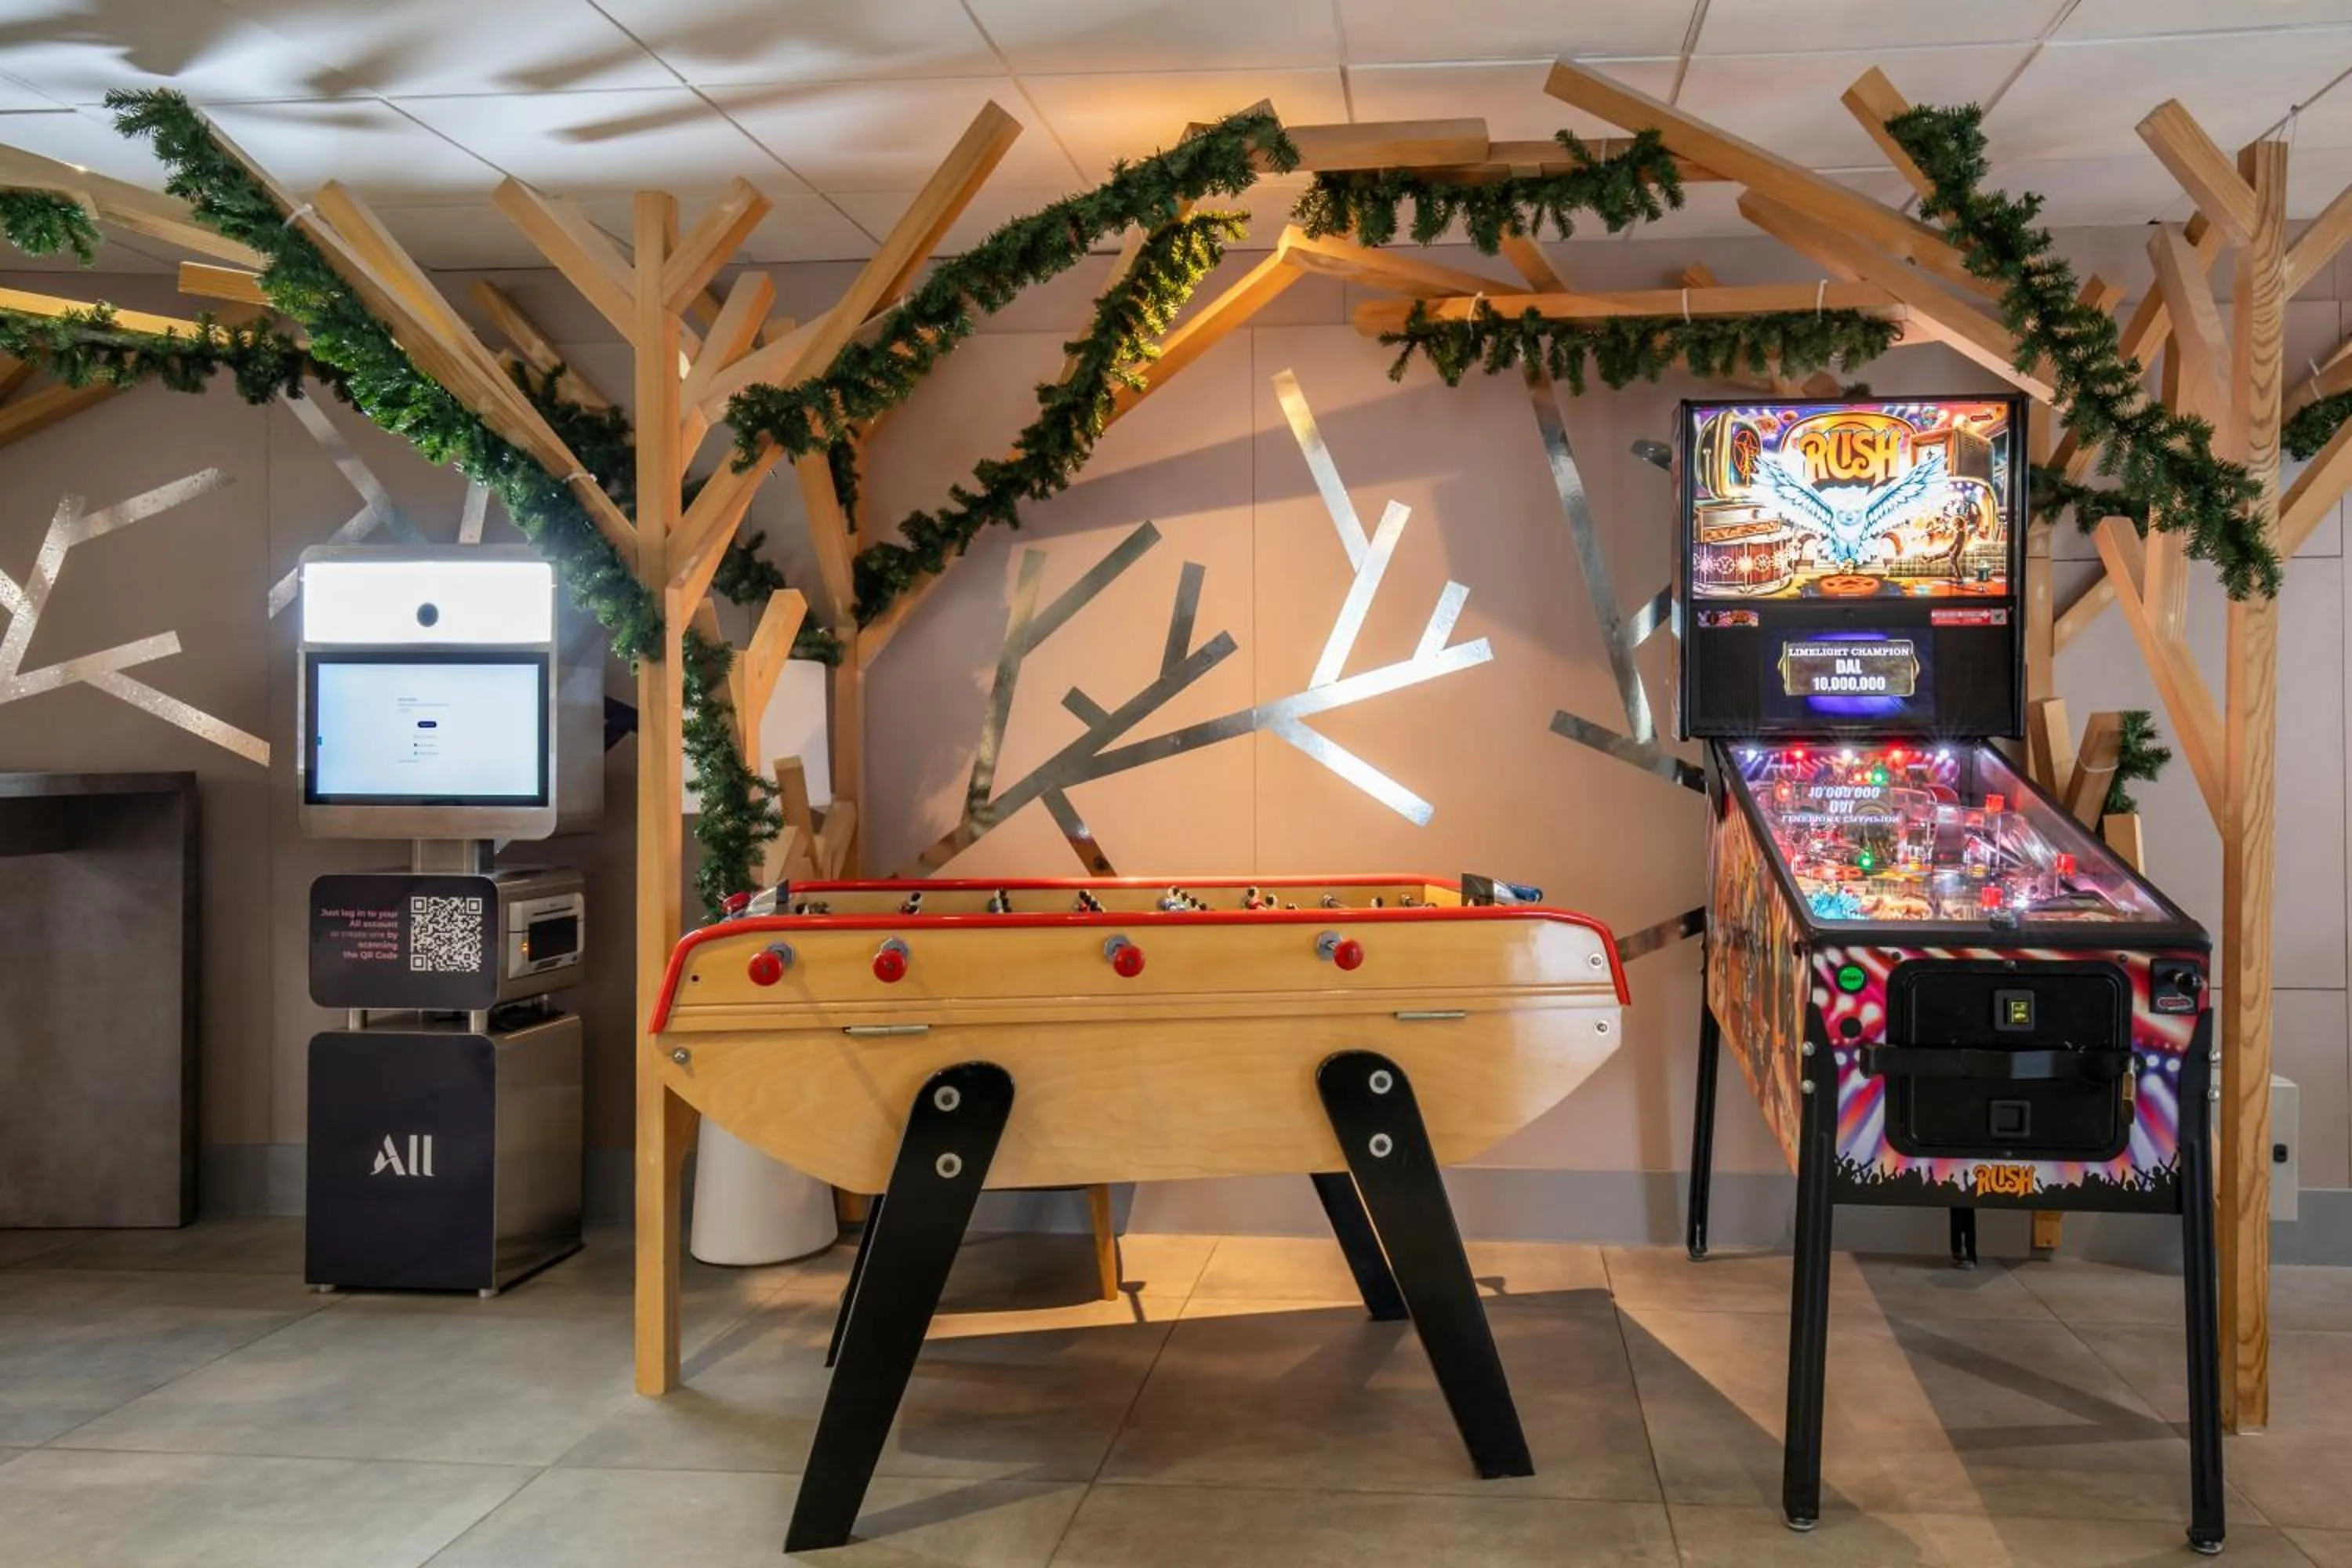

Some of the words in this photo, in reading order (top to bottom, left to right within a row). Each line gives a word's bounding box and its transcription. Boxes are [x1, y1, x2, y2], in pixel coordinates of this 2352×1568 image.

[1800, 430, 1901, 486] RUSH
[1789, 648, 1847, 656] LIMELIGHT
[1835, 659, 1863, 674] DAL
[1813, 677, 1886, 691] 10,000,000
[341, 909, 355, 918] log
[387, 931, 398, 940] by
[358, 942, 398, 951] scanning
[360, 951, 374, 960] QR
[1974, 1164, 2035, 1198] RUSH
